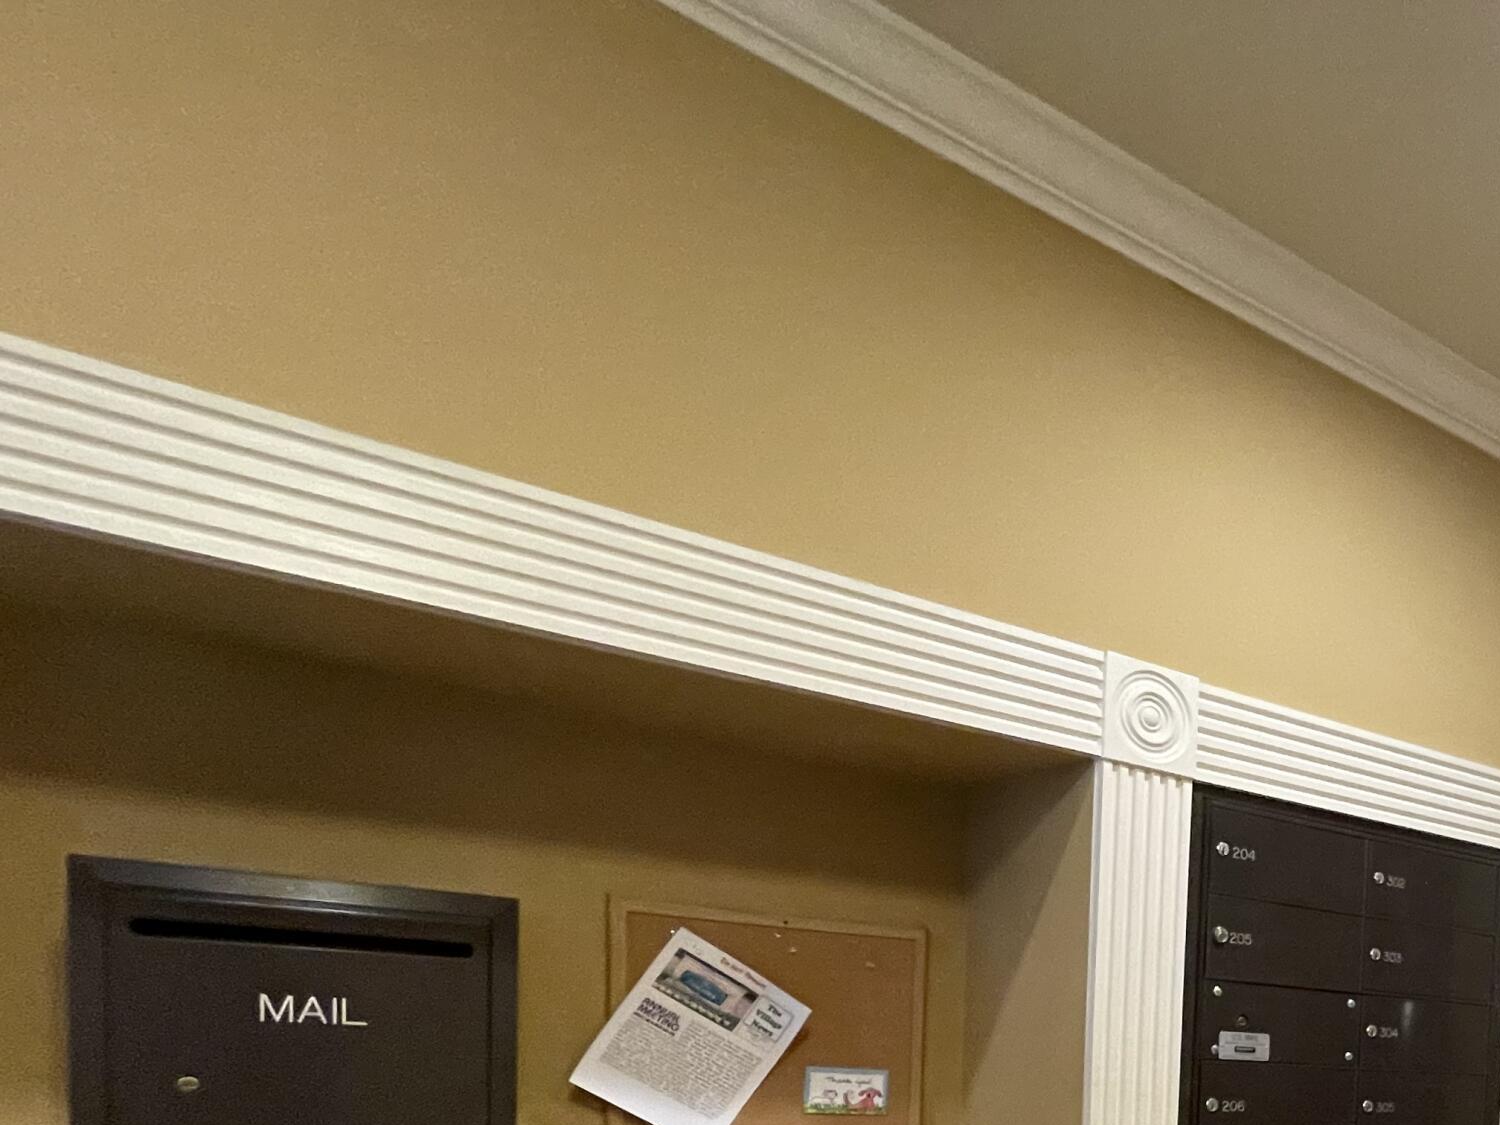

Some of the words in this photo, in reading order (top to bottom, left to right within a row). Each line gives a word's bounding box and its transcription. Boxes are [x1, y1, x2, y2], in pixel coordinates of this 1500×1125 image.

[1232, 846, 1256, 862] 204
[1229, 931, 1252, 946] 205
[259, 993, 368, 1026] MAIL
[636, 1004, 680, 1031] MEETING
[641, 997, 680, 1023] ANNUAL
[768, 1004, 783, 1017] The
[752, 1019, 773, 1037] News
[756, 1009, 783, 1030] Village
[1221, 1099, 1246, 1113] 206
